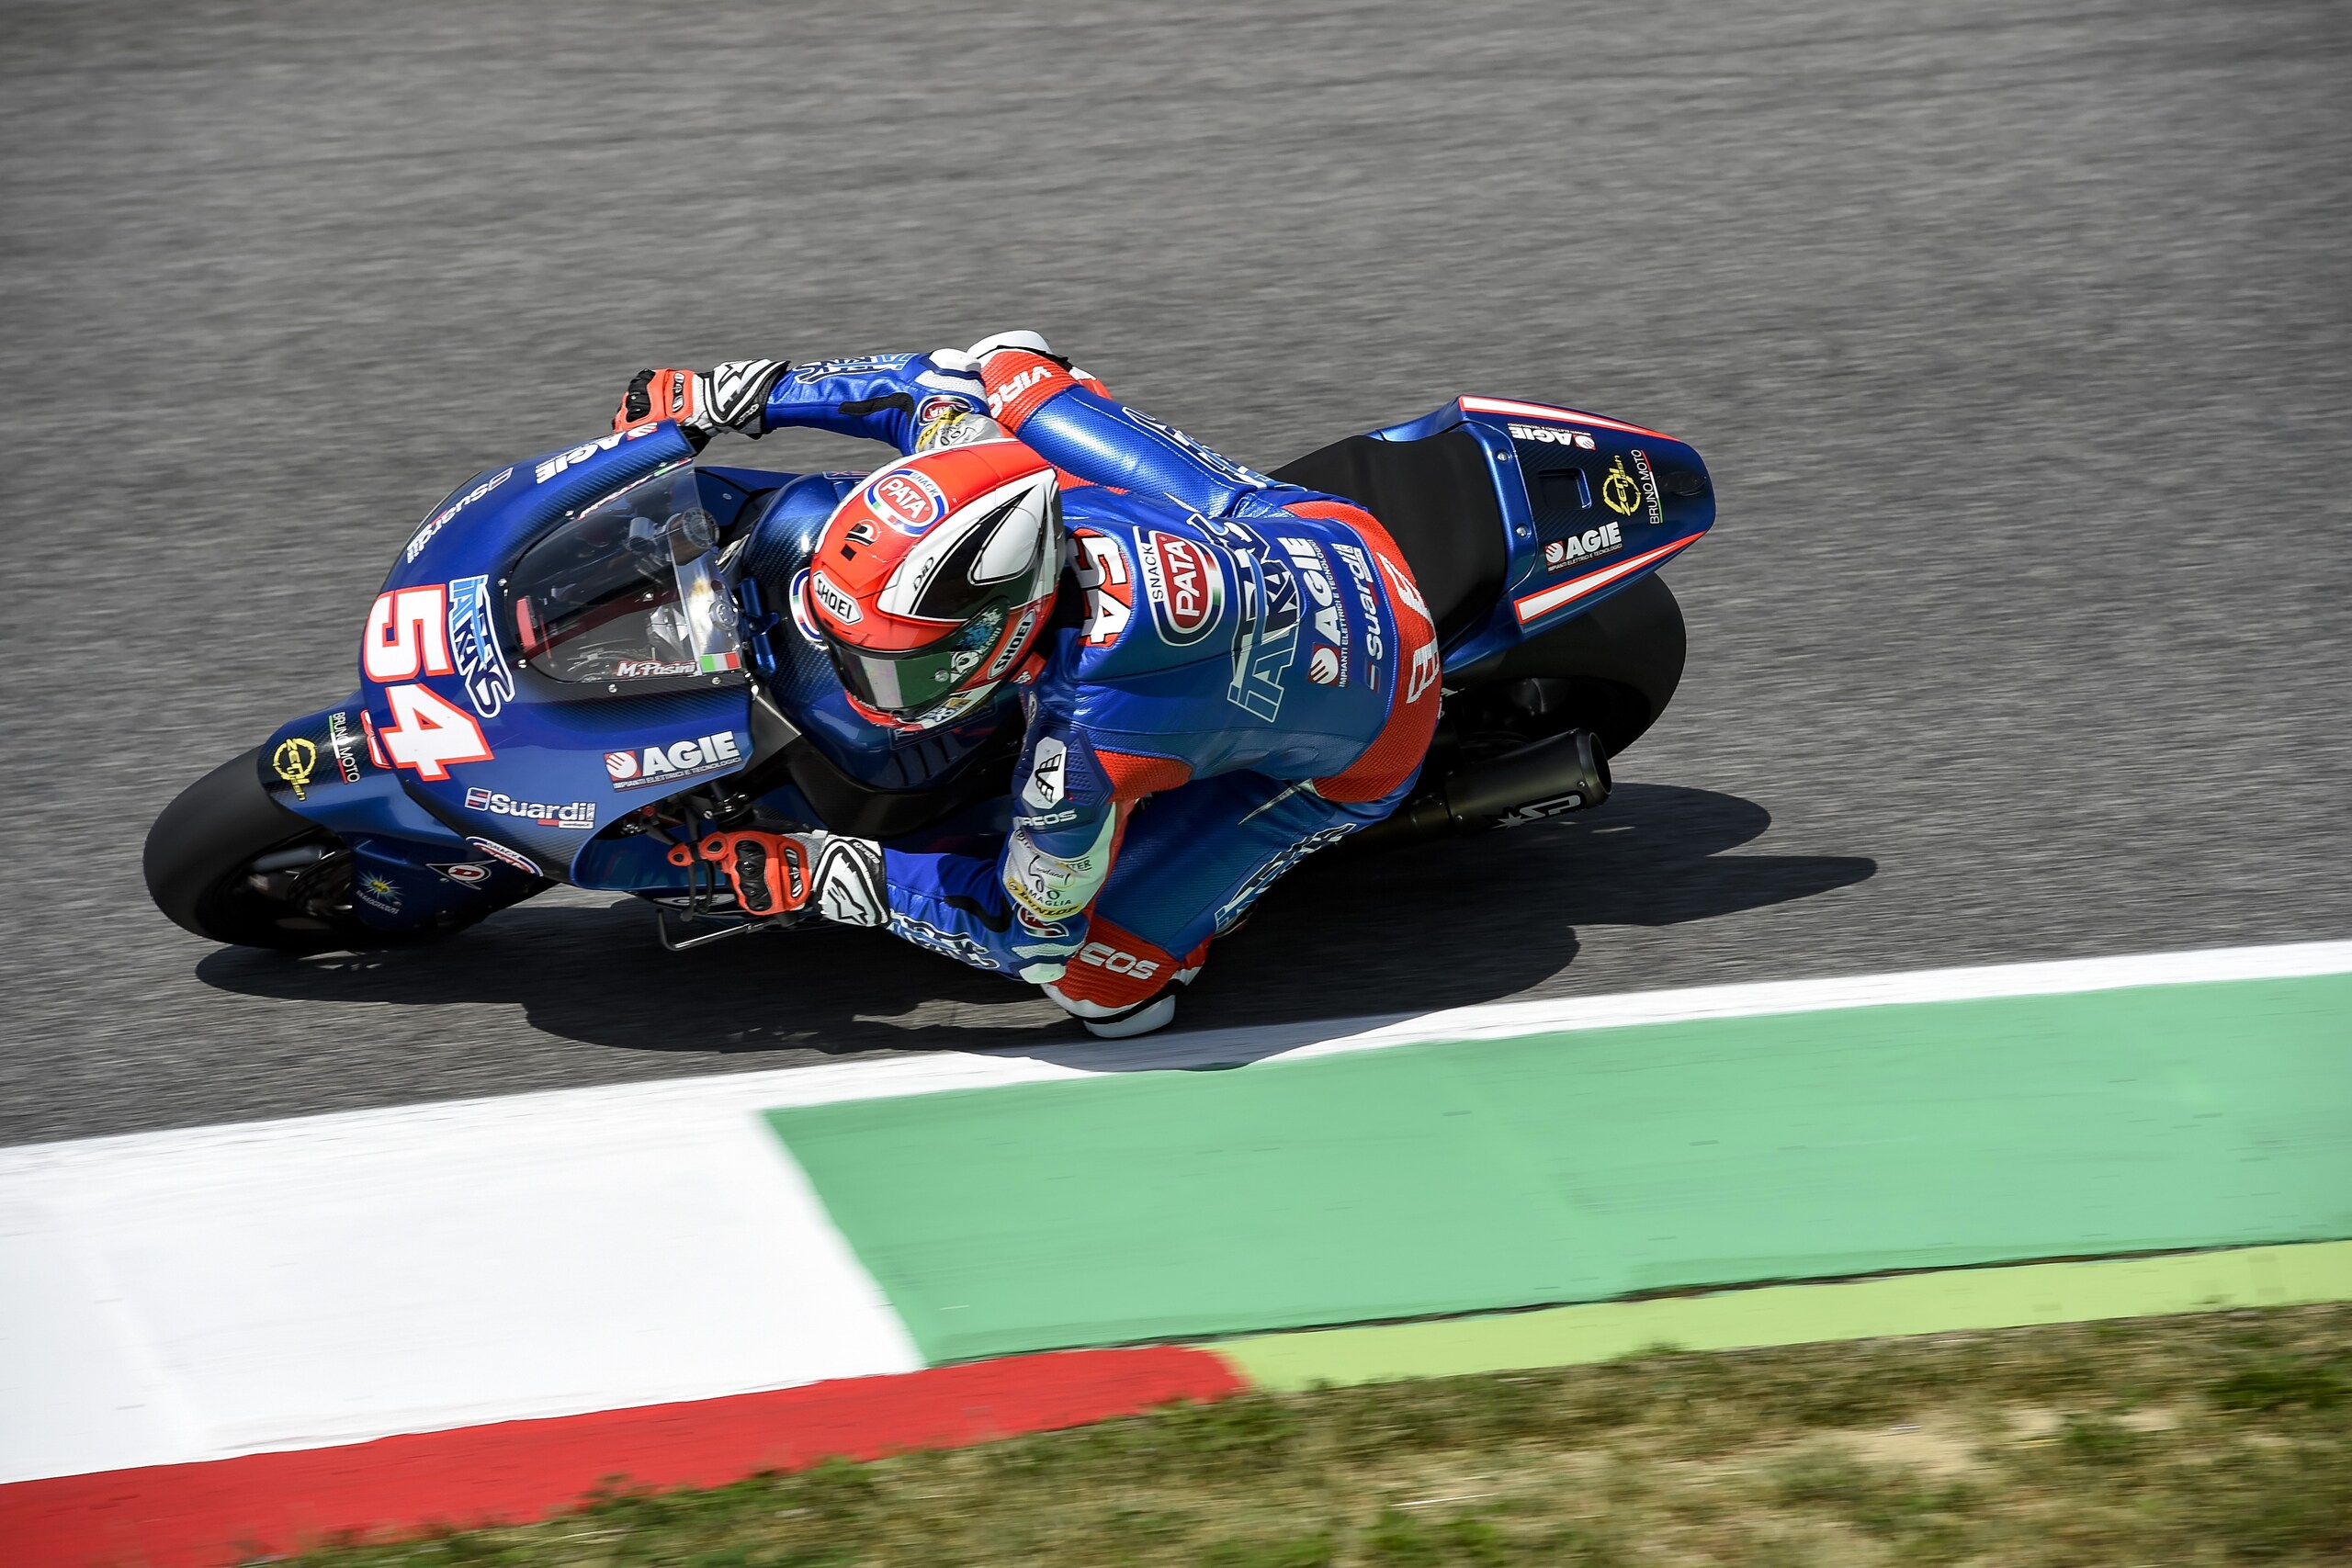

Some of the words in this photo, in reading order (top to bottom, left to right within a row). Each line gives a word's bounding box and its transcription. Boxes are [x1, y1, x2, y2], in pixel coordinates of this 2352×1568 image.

[536, 431, 627, 484] AGIE
[1508, 426, 1573, 446] AGIE
[910, 472, 939, 496] SNACK
[1631, 449, 1650, 480] MOTO
[880, 479, 927, 518] PATA
[1643, 483, 1659, 525] BRUNO
[1566, 521, 1622, 560] AGIE
[1141, 545, 1164, 600] SNACK
[1163, 540, 1200, 616] PATA
[1307, 539, 1338, 591] TECNOLOGICI
[815, 578, 853, 620] SHOEI
[1067, 536, 1131, 644] 54
[1277, 537, 1340, 647] AGIE
[1336, 601, 1348, 645] ELETTRICI
[994, 621, 1032, 670] SHOEI
[1339, 646, 1348, 687] IMPIANTI
[364, 582, 494, 782] 54
[333, 712, 349, 745] BRUNO
[340, 746, 360, 783] MOTO
[642, 730, 740, 776] AGIE
